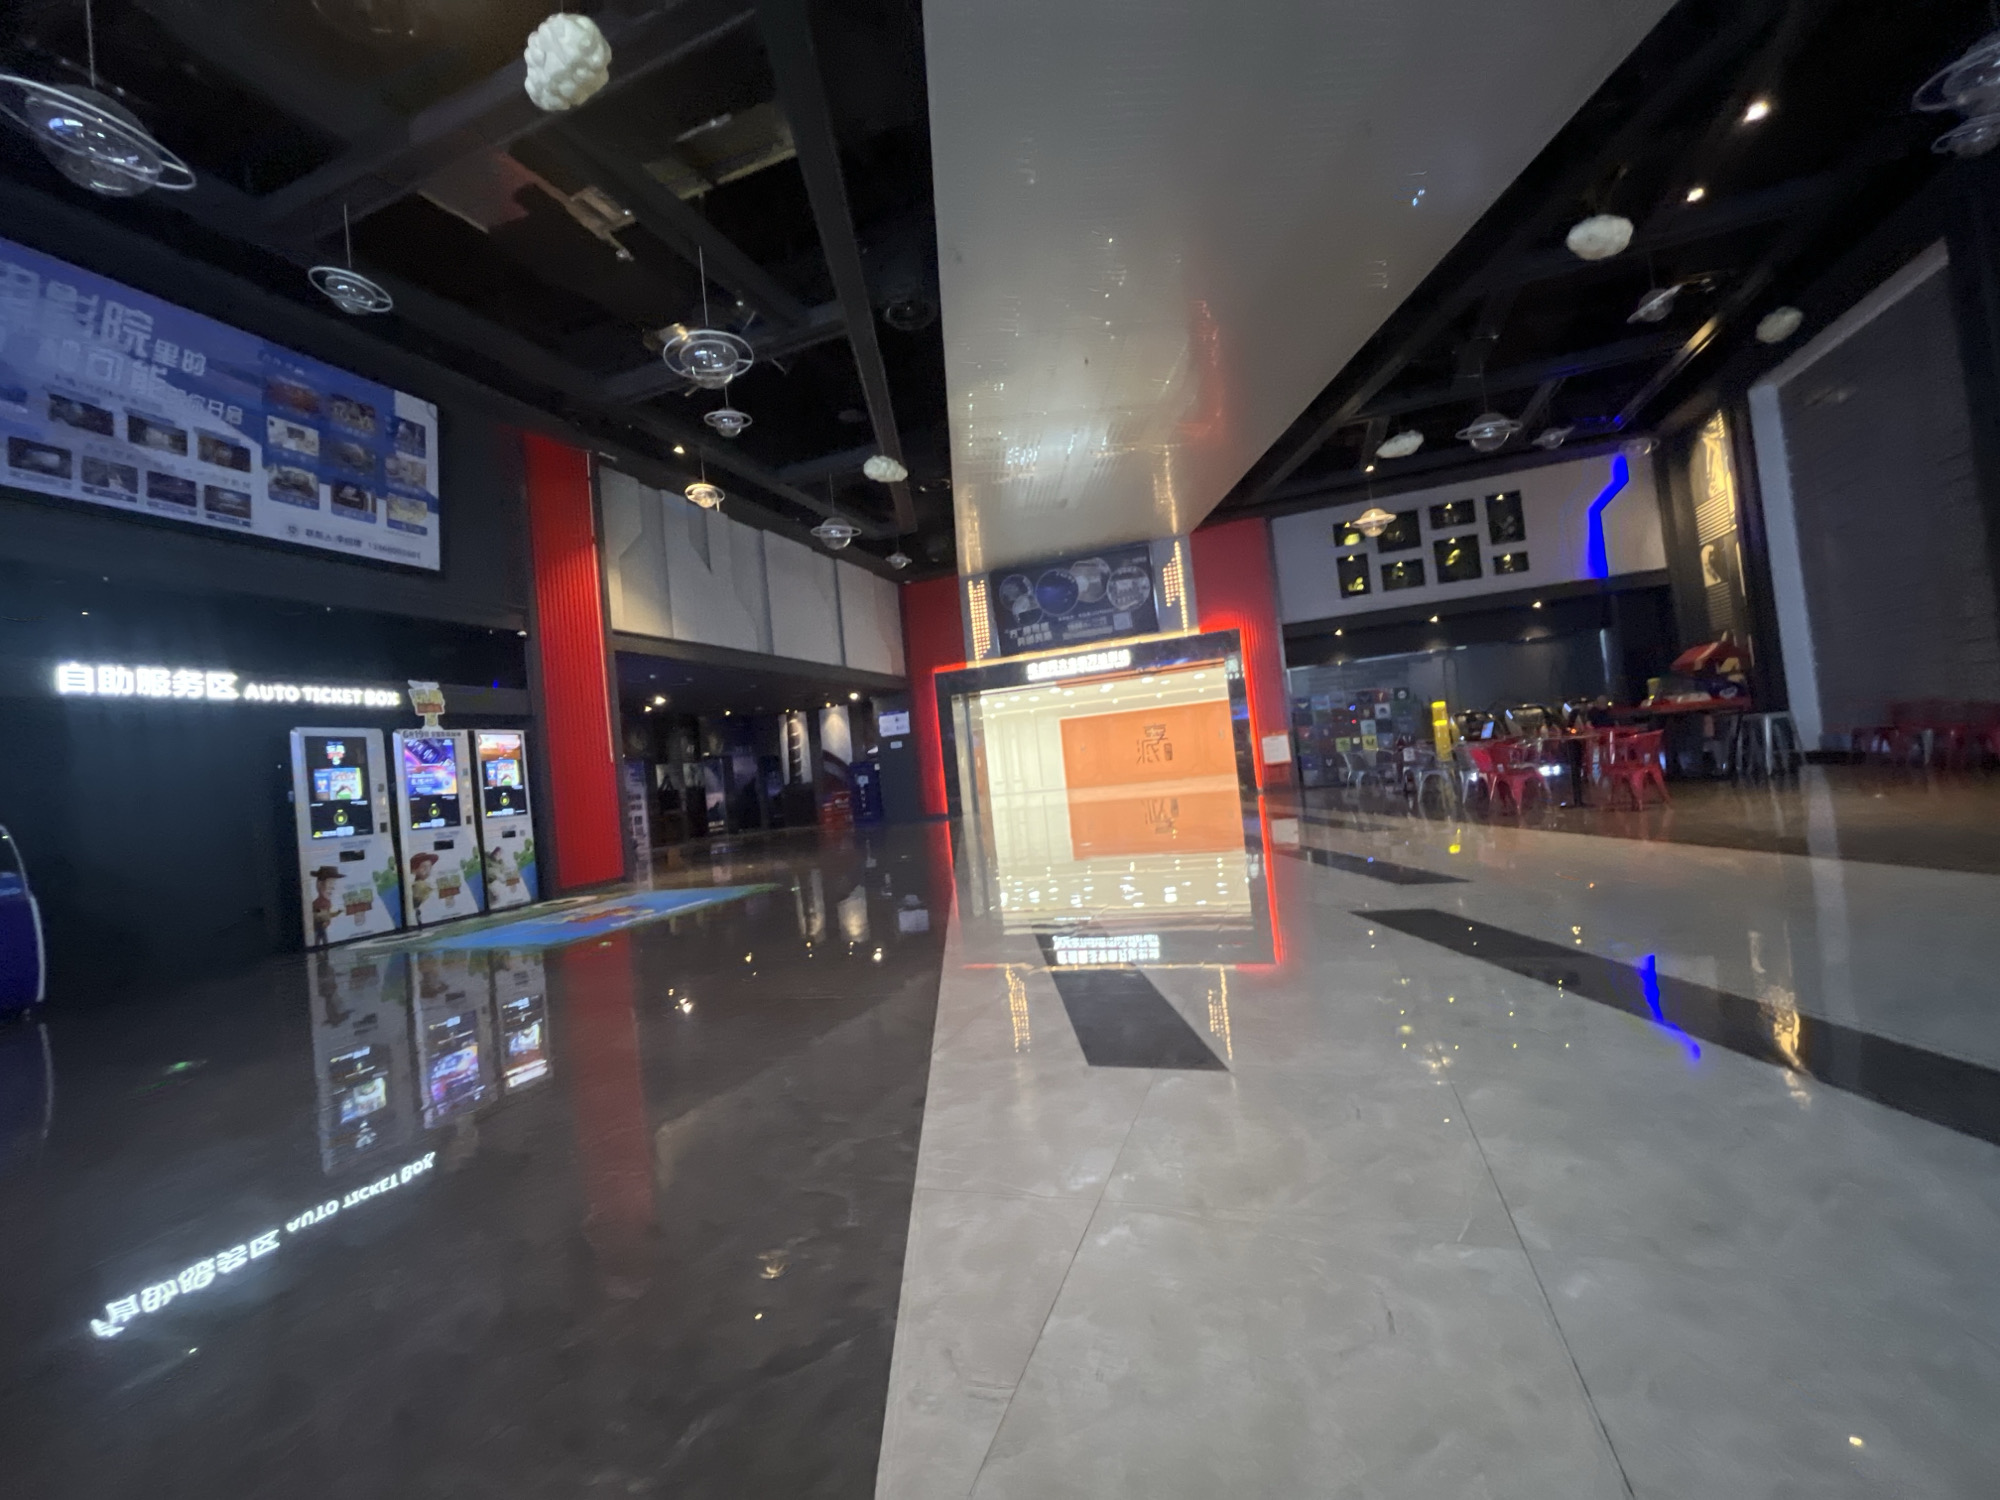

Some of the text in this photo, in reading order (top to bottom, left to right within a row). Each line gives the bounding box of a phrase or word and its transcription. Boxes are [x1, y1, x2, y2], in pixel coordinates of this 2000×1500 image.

[57, 663, 239, 700] 自助服务区
[245, 683, 299, 702] AUTO
[301, 685, 363, 705] TICKET
[364, 688, 400, 707] BOX
